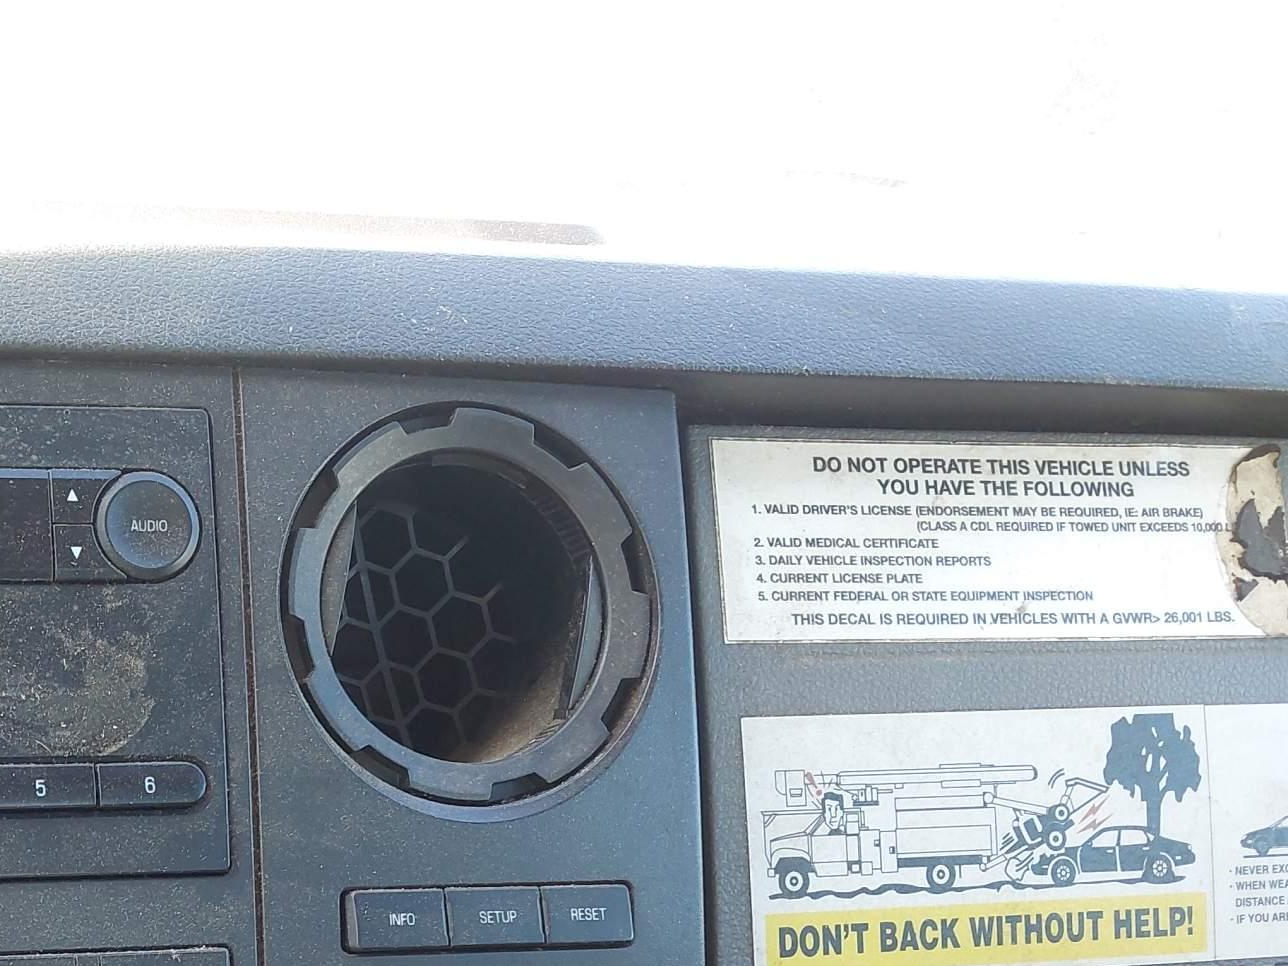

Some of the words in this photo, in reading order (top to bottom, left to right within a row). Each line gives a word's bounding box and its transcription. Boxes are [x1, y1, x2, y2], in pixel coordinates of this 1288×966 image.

[812, 457, 842, 473] DO
[848, 457, 888, 473] NOT
[894, 458, 983, 474] OPERATE
[986, 459, 1030, 475] THIS
[1034, 460, 1113, 476] VEHICLE
[1119, 461, 1191, 477] UNLESS
[877, 479, 919, 495] YOU
[925, 480, 976, 496] HAVE
[980, 480, 1018, 496] THE
[1024, 481, 1135, 497] FOLLOWING
[752, 505, 762, 515] 1.
[764, 504, 799, 515] VALID
[803, 504, 858, 516] DRIVER'S
[861, 505, 913, 516] LICENSE
[915, 505, 1010, 518] (ENDORSEMENT
[1013, 507, 1038, 517] MAY
[1041, 507, 1057, 517] BE
[1059, 507, 1123, 519] REQUIRED,
[1141, 507, 1160, 518] AIR
[1163, 507, 1204, 519] BRAKE)
[130, 520, 169, 533] AUDIO
[917, 521, 957, 533] (CLASS
[960, 521, 968, 532] A
[970, 521, 993, 532] CDL
[996, 521, 1054, 532] REQUIRED
[1056, 522, 1067, 532] IF
[1069, 522, 1109, 533] TOWED
[1112, 522, 1136, 533] UNIT
[1140, 522, 1189, 533] EXCEEDS
[1191, 522, 1223, 534] 10,000
[754, 538, 764, 548] 2.
[767, 537, 802, 548] VALID
[805, 537, 860, 549] MEDICAL
[863, 538, 939, 549] CERTIFICATE
[755, 555, 766, 566] 3.
[768, 555, 803, 566] DAILY
[806, 555, 858, 566] VEHICLE
[860, 555, 933, 567] INSPECTION
[936, 555, 992, 567] REPORTS
[756, 573, 767, 584] 4.
[770, 573, 829, 584] CURRENT
[832, 573, 883, 584] LICENSE
[886, 573, 923, 584] PLATE
[758, 591, 768, 602] 5.
[771, 590, 830, 602] CURRENT
[833, 591, 889, 602] FEDERAL
[891, 591, 909, 602] OR
[912, 591, 948, 602] STATE
[950, 591, 1019, 602] EQUIPMENT
[1023, 590, 1094, 602] INSPECTION
[791, 613, 825, 626] THIS
[828, 613, 876, 626] DECAL
[880, 613, 893, 626] IS
[896, 613, 969, 626] REQUIRED
[973, 613, 987, 625] IN
[990, 612, 1058, 626] VEHICLES
[1060, 612, 1096, 625] WITH
[1100, 612, 1110, 625] A
[1112, 612, 1161, 625] GVWR>
[1164, 611, 1203, 625] 26,001
[1207, 611, 1236, 623] LBS.
[34, 779, 47, 798] 5
[144, 776, 157, 795] 6
[1235, 865, 1270, 876] NEVER
[1235, 880, 1266, 891] WHEN
[1235, 896, 1285, 908] DISTANCE
[389, 911, 416, 926] INFO
[479, 910, 517, 924] SETUP
[570, 907, 607, 922] RESET
[1237, 914, 1246, 924] IF
[1248, 913, 1270, 923] YOU
[778, 922, 869, 959] DON'T
[879, 918, 960, 954] BACK
[969, 911, 1103, 950] WITHOUT
[1113, 905, 1194, 940] HELP!
